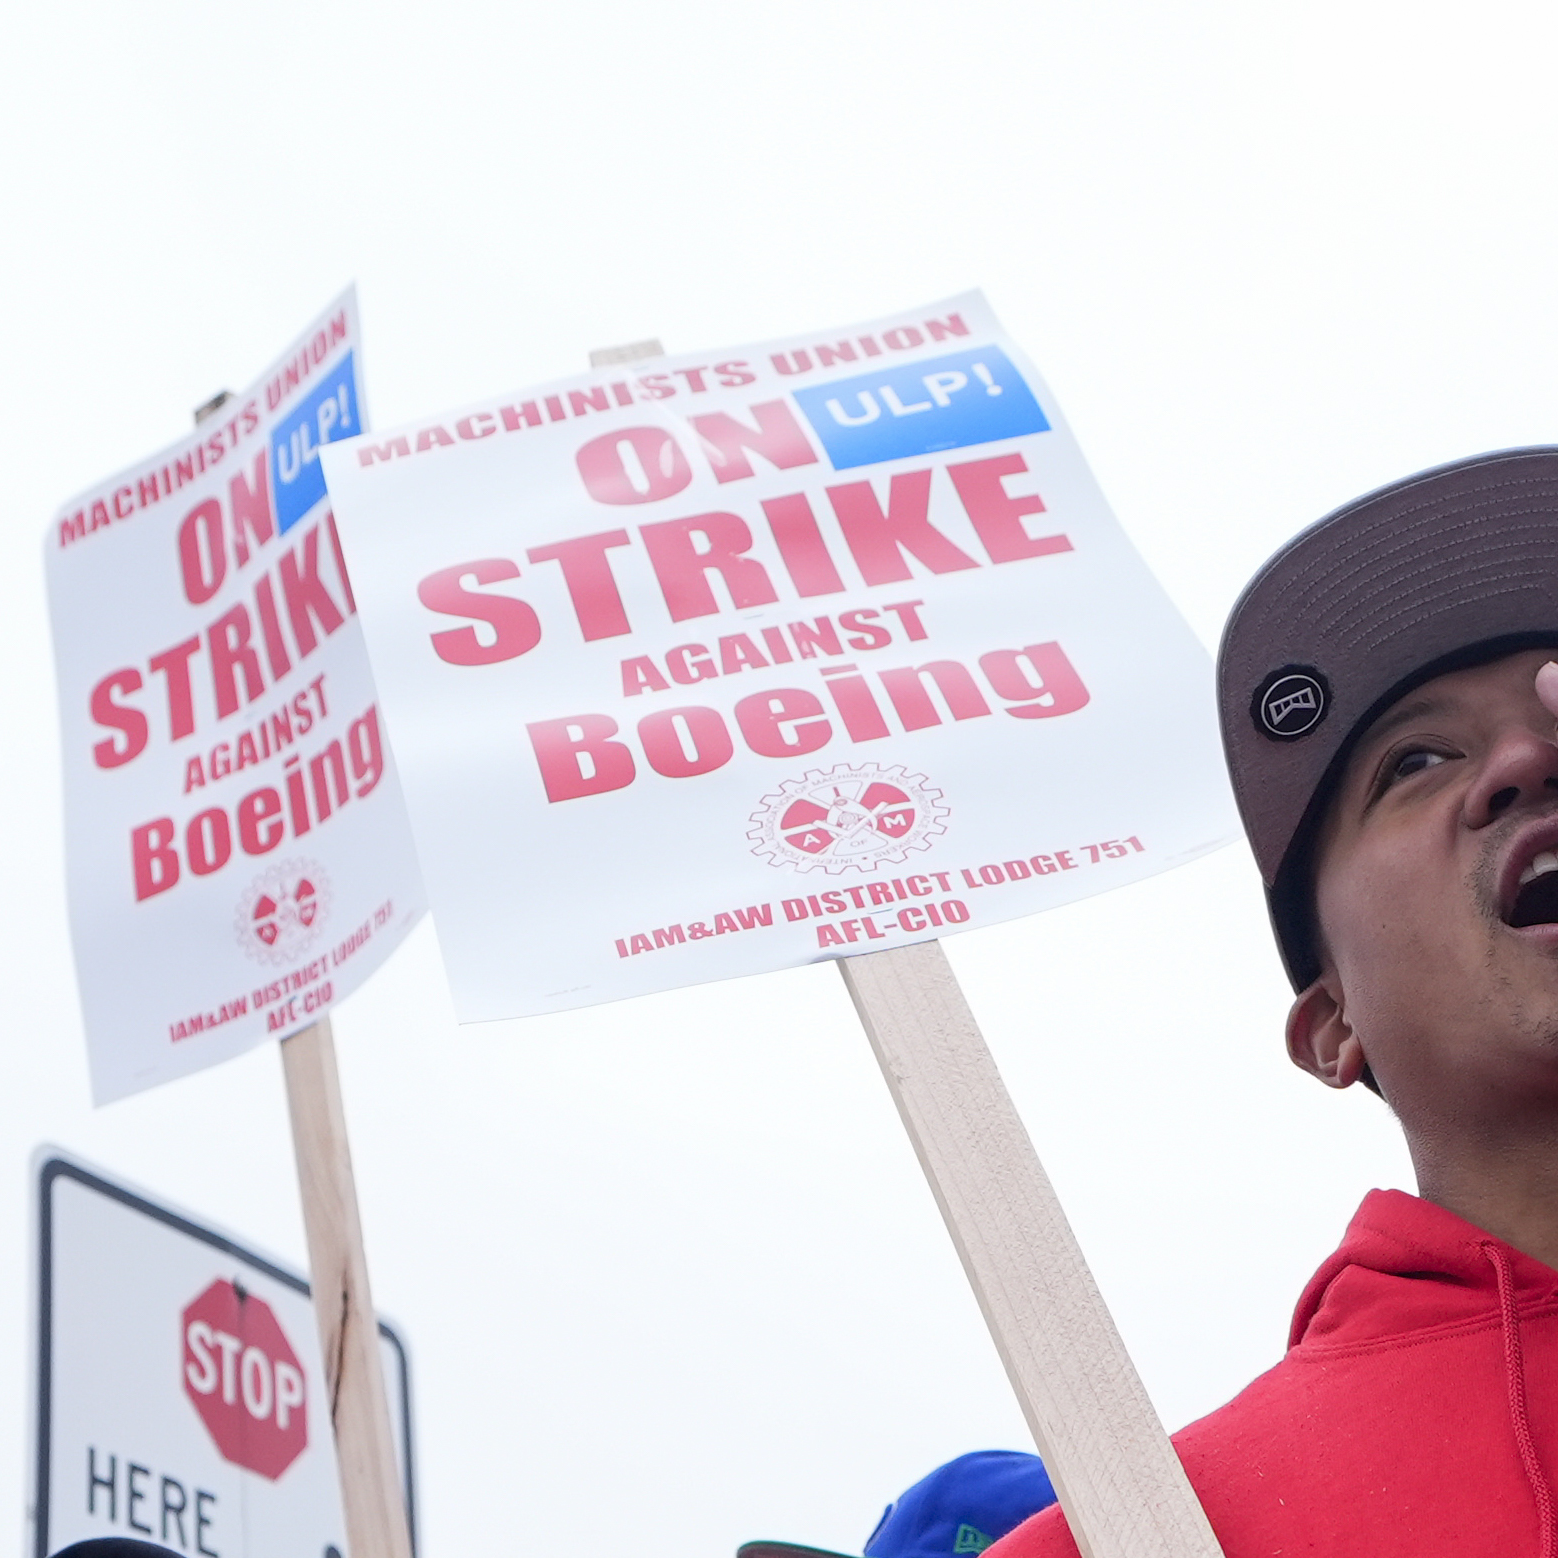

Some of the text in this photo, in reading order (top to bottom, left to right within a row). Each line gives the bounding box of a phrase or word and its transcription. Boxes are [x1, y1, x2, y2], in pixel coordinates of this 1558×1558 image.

[58, 308, 348, 549] MACHINISTS UNION
[278, 384, 351, 484] ULP!
[357, 313, 972, 468] MACHINISTS UNION
[826, 363, 1004, 428] ULP!
[574, 398, 820, 508] ON
[177, 446, 274, 605] ON
[415, 451, 1076, 667] STRIKE
[620, 598, 931, 698] AGAINST
[184, 673, 329, 795] AGAINST
[526, 639, 1092, 804] Boeing
[130, 704, 384, 903] Boeing
[614, 903, 774, 958] IAM&AW
[782, 871, 953, 922] DISTRICT
[962, 851, 1076, 889] LODGE
[1082, 836, 1146, 865] 751
[816, 899, 972, 948] AFL-CIO
[169, 996, 248, 1043] IAM&AW
[251, 953, 329, 1010] DISTRICT
[266, 980, 334, 1033] AFL-CIO
[186, 1319, 306, 1430] STOP
